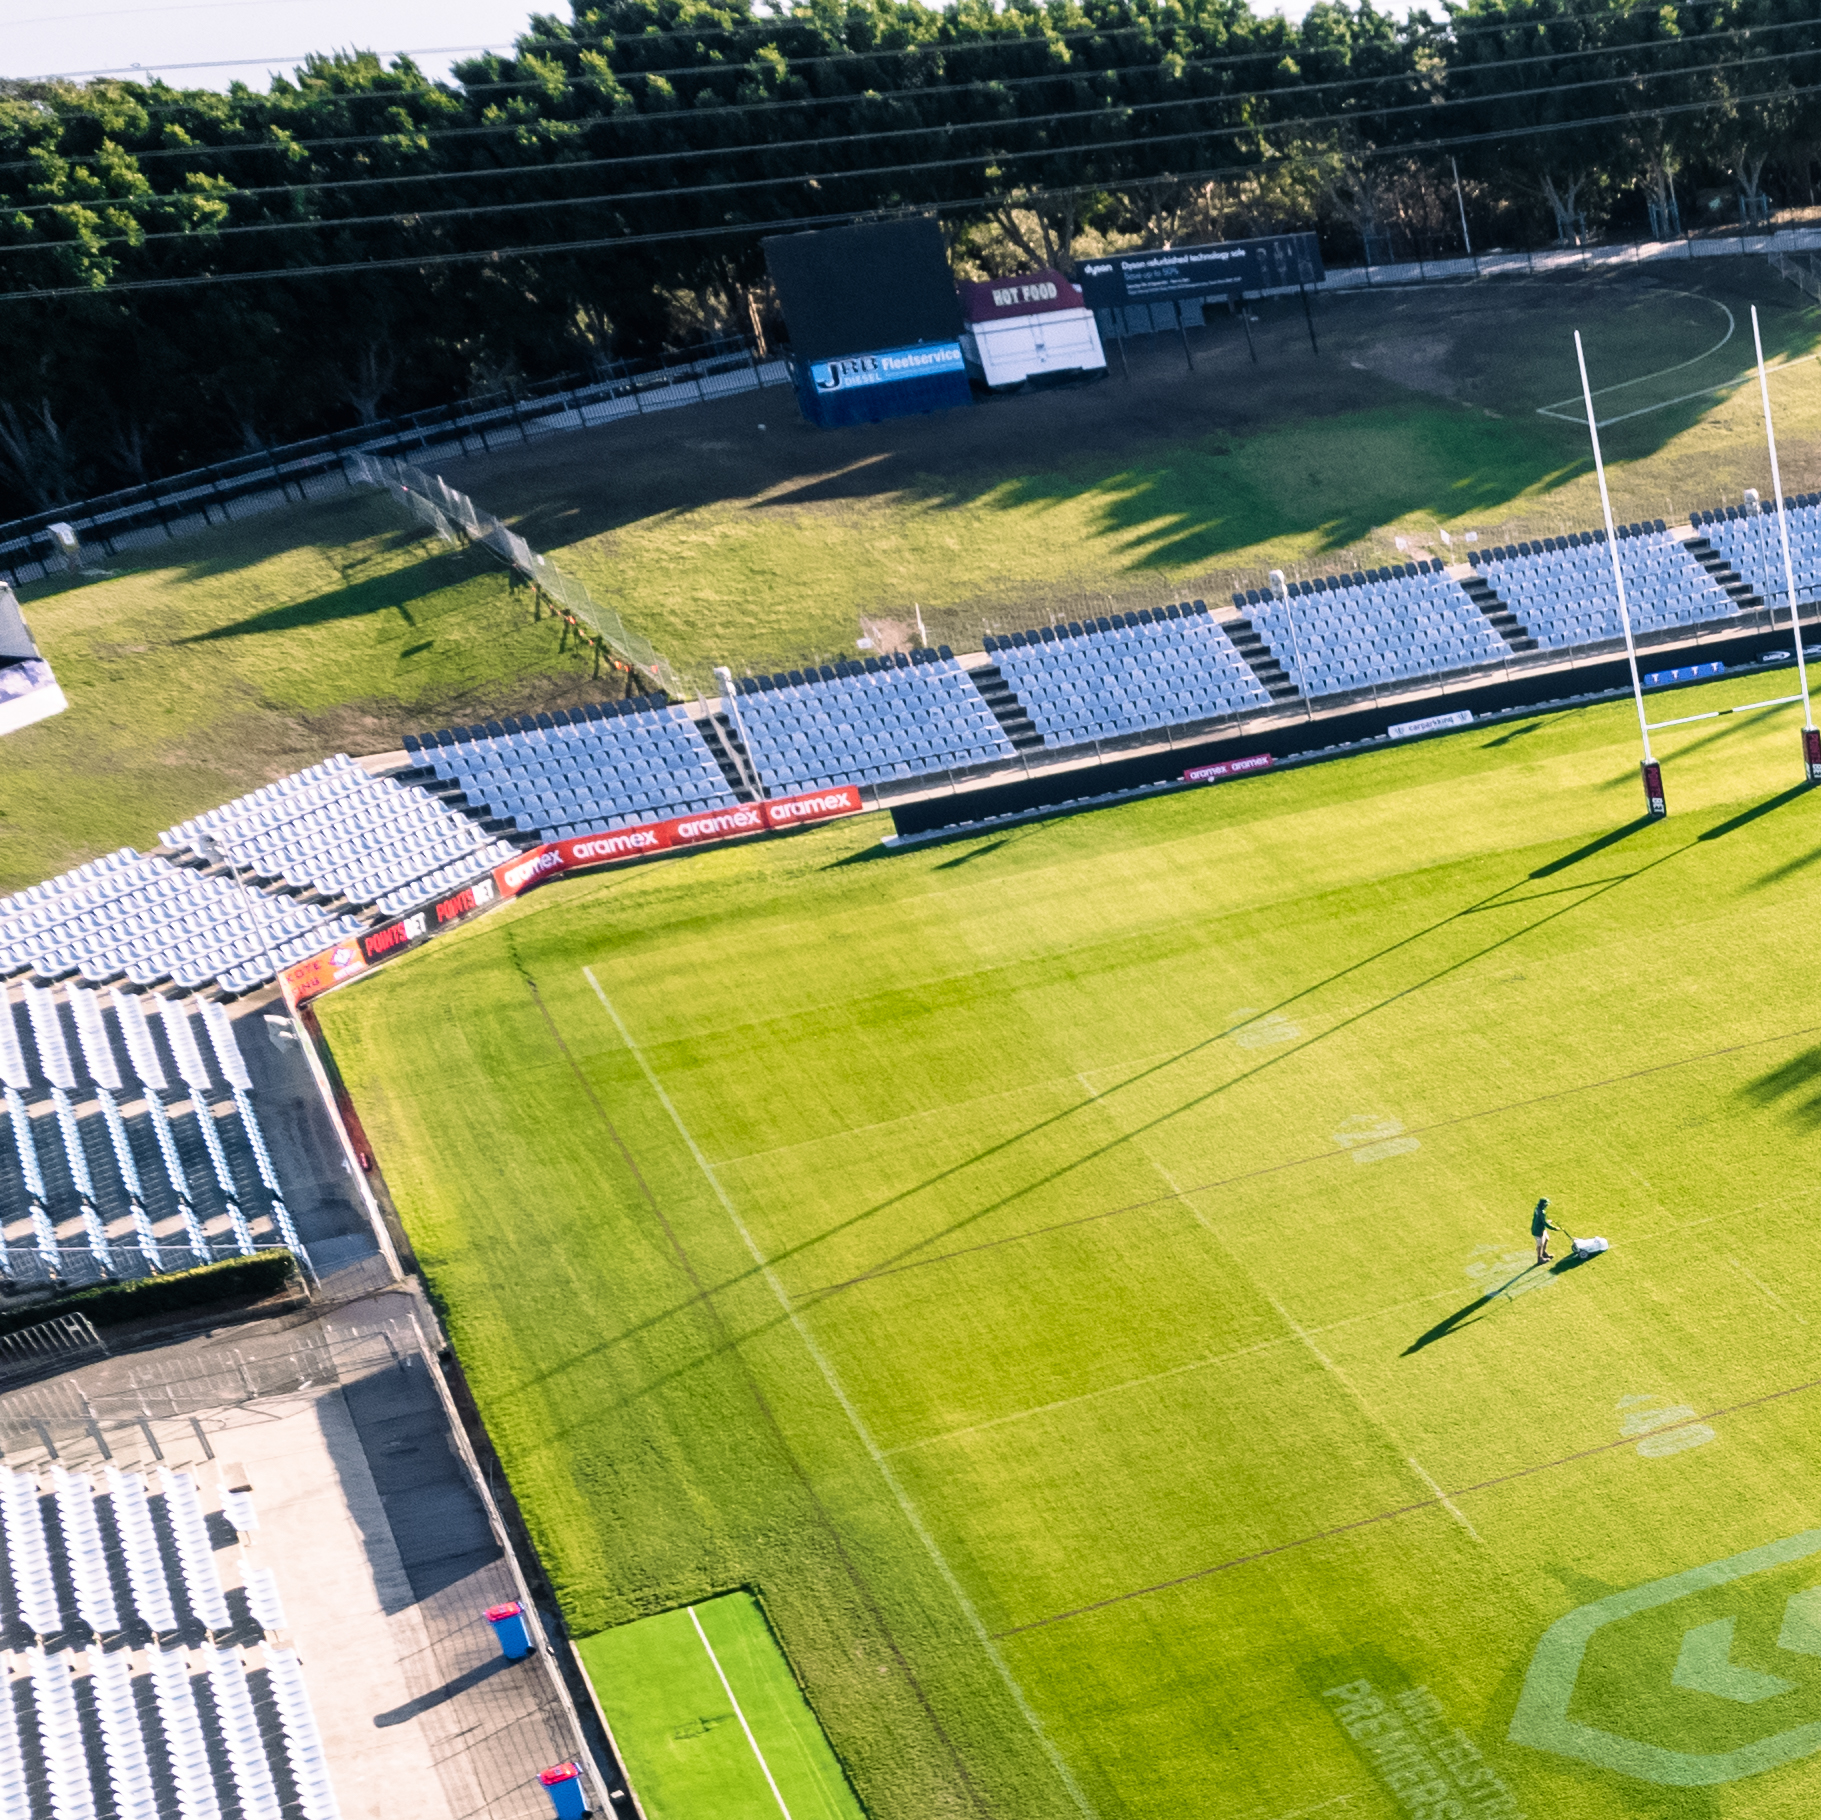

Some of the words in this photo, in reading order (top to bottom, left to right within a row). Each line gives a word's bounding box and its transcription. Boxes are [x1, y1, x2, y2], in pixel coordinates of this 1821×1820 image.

[992, 286, 1020, 306] HOT
[1022, 281, 1058, 301] FOOD
[881, 348, 961, 371] Fleetservice
[1190, 764, 1227, 780] aramex
[1231, 754, 1268, 771] aramex
[770, 791, 851, 820] aramex
[677, 808, 761, 839] aramex
[573, 829, 659, 859] aramex
[504, 847, 564, 887] aramex
[436, 878, 494, 923] POINTSBET
[365, 912, 427, 958] POINTSBET
